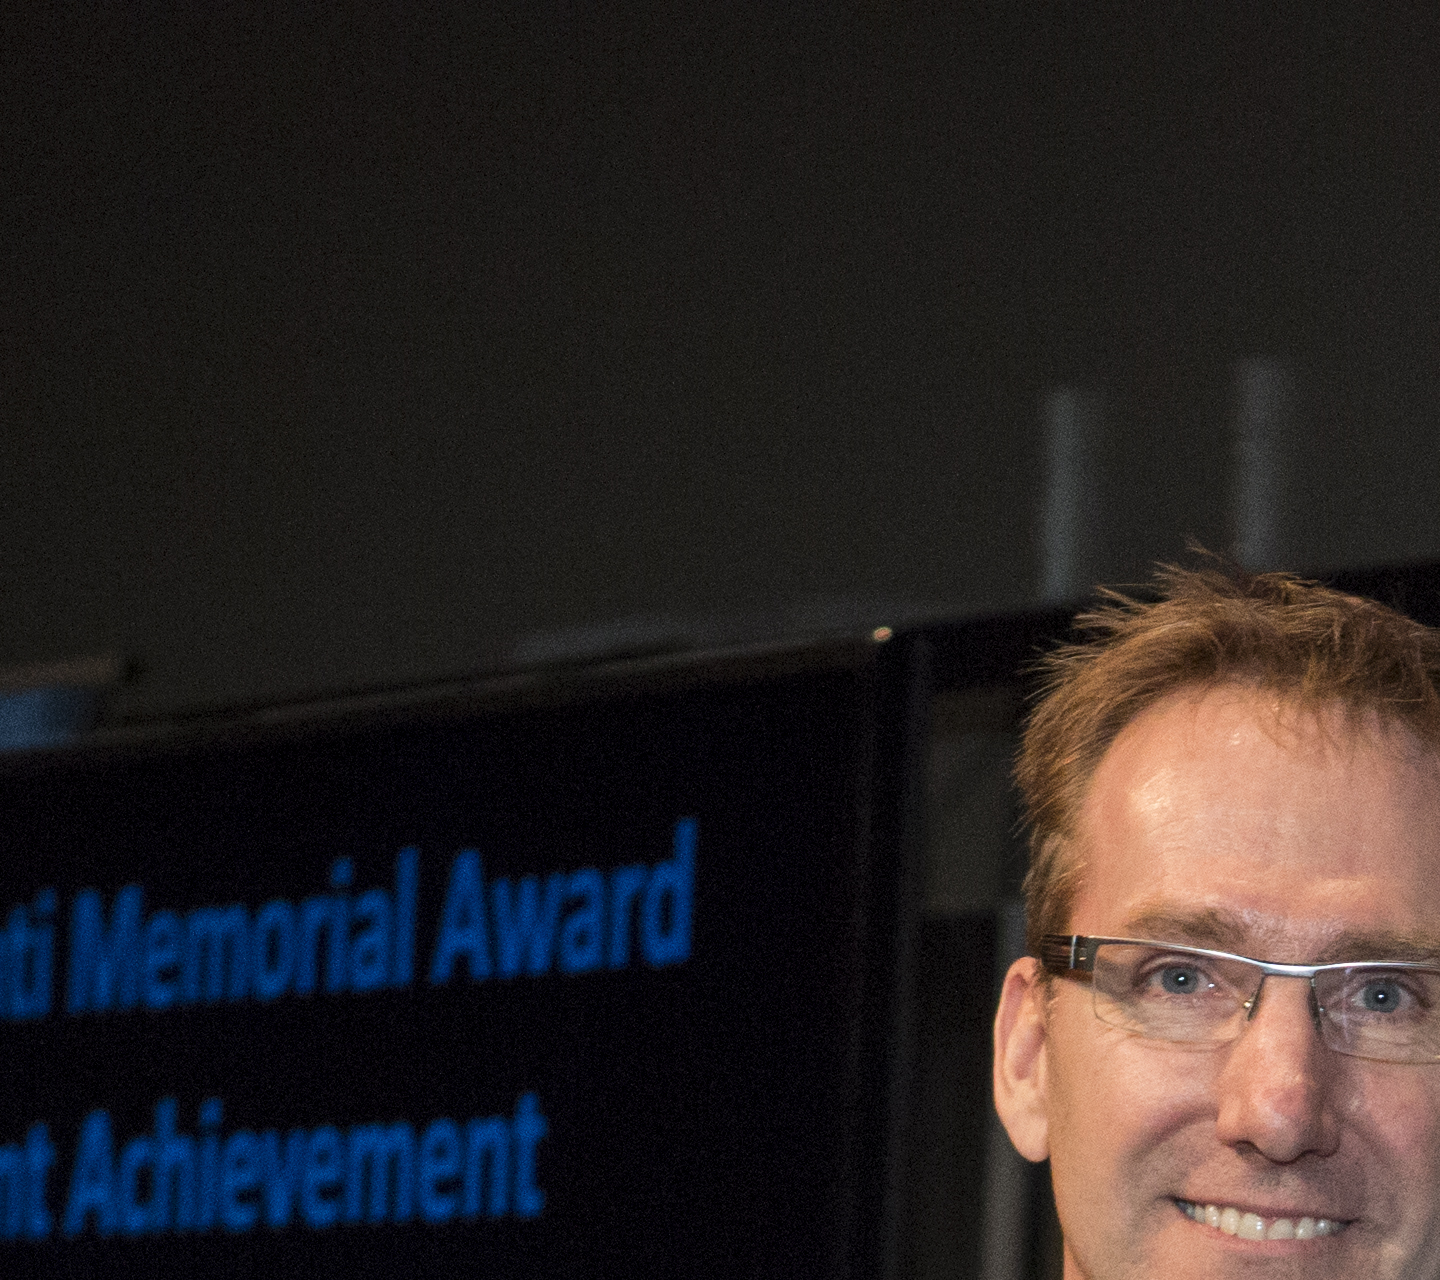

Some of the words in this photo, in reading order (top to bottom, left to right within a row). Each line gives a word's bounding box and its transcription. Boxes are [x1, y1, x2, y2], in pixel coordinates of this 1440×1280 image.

[66, 848, 418, 1016] Memorial
[431, 816, 698, 983] Award
[64, 1092, 547, 1239] Achievement
